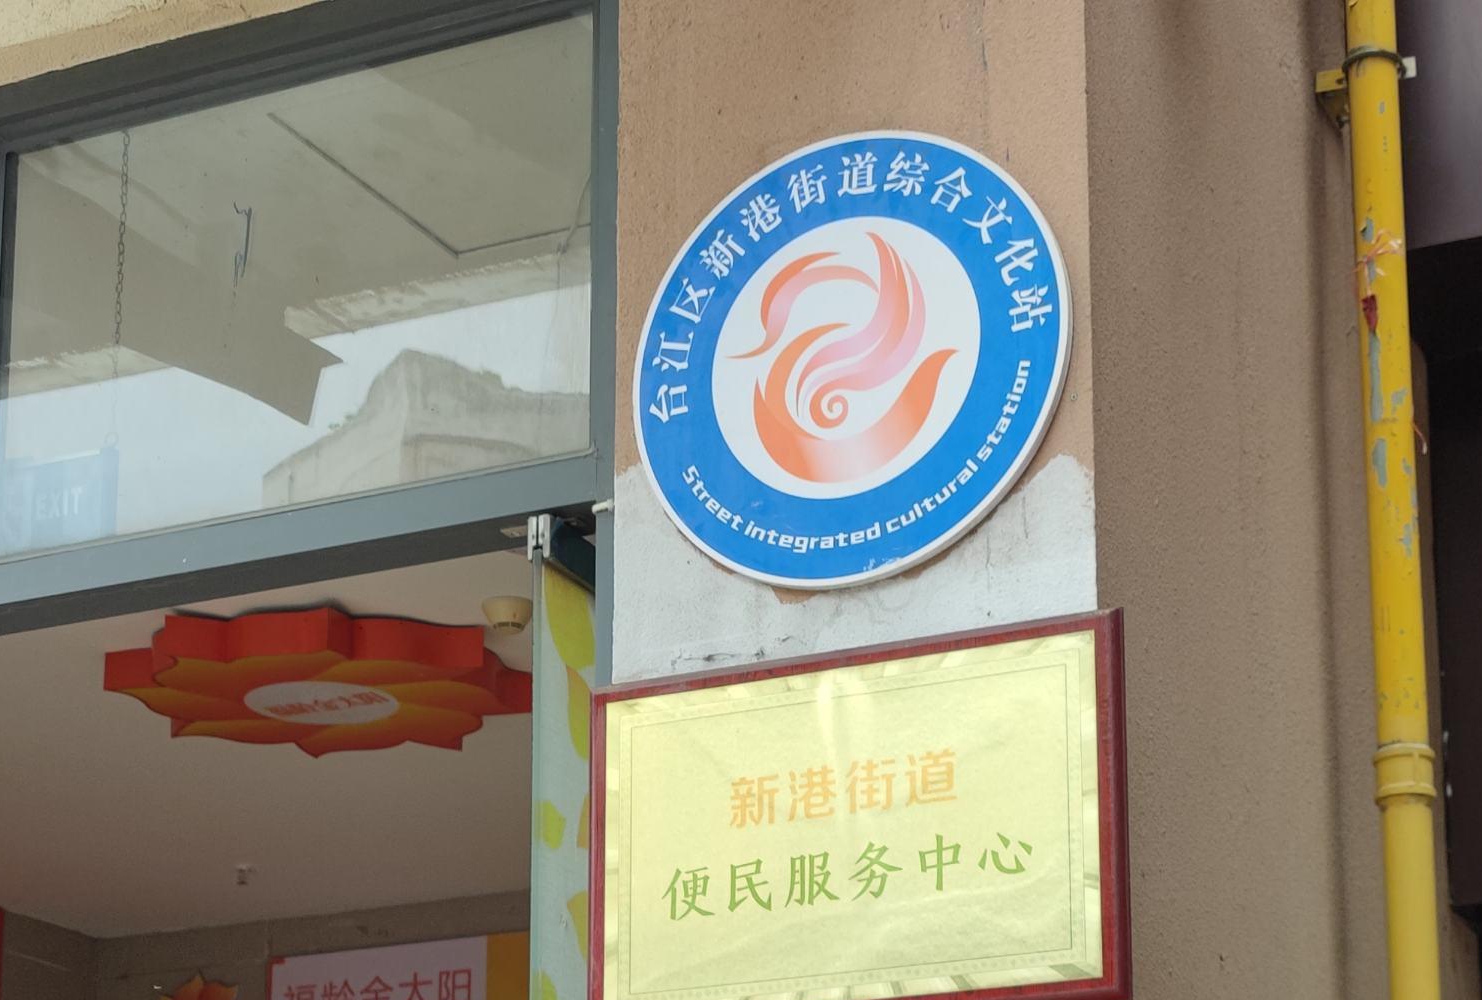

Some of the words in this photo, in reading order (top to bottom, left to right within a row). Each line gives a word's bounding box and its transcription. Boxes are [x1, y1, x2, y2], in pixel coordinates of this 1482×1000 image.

[649, 152, 1052, 424] 台江区新港街道综合文化站
[682, 465, 743, 531] Street
[744, 521, 881, 553] integrated
[886, 459, 979, 532] cultural
[978, 360, 1030, 461] station
[729, 748, 958, 830] 新港街道
[661, 832, 1034, 922] 便民服务中心
